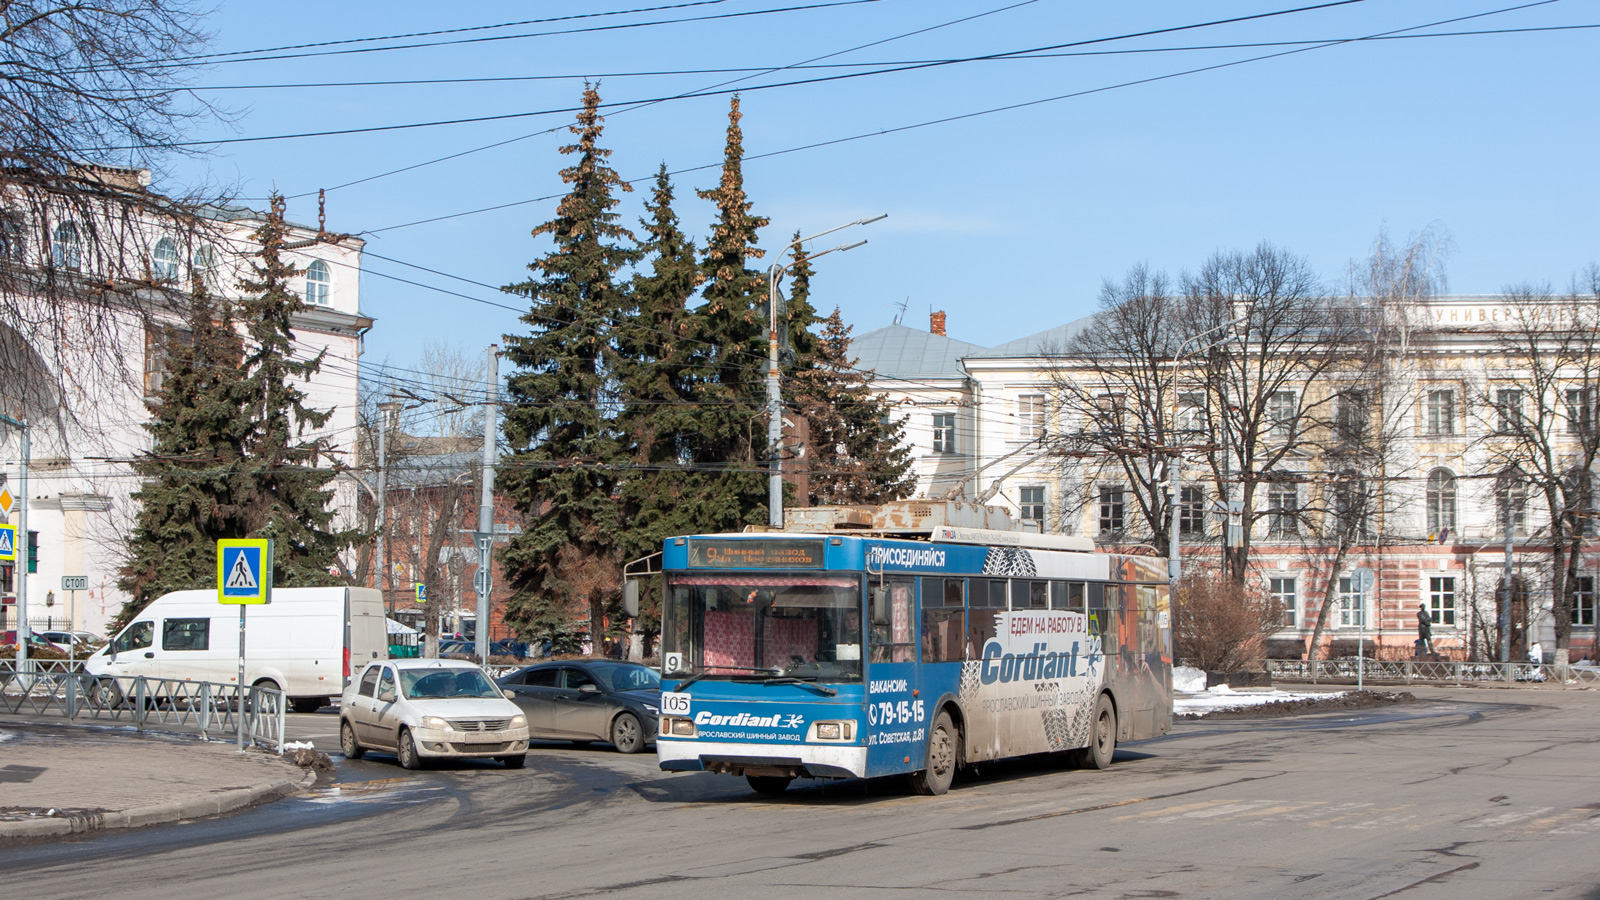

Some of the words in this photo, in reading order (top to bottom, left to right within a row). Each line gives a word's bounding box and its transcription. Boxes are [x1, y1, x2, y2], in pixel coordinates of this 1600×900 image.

[706, 547, 717, 563] 9
[871, 547, 946, 568] ПРИСОЕДИНЯЙСЯ
[65, 578, 85, 588] СТОП
[1011, 617, 1033, 637] ЕДЕМ
[1035, 617, 1046, 634] НА
[1047, 617, 1076, 634] РАБОТУ
[1077, 617, 1083, 633] В
[668, 656, 678, 671] 9
[980, 640, 1080, 685] Cordiant
[870, 679, 908, 694] ВАКАНСИИ:
[663, 696, 688, 711] 105
[982, 694, 1029, 713] ЯРОСЛАВСКИЙ
[1030, 691, 1059, 709] ШИННЫЙ
[1059, 692, 1079, 707] ЗАВОД
[694, 711, 782, 728] Cordiant
[878, 700, 925, 725] 79-15-15
[698, 730, 745, 739] ЯРОСЛАВСКИЙ
[747, 731, 777, 740] ШИННЫЙ
[778, 733, 800, 741] ЗАВОД
